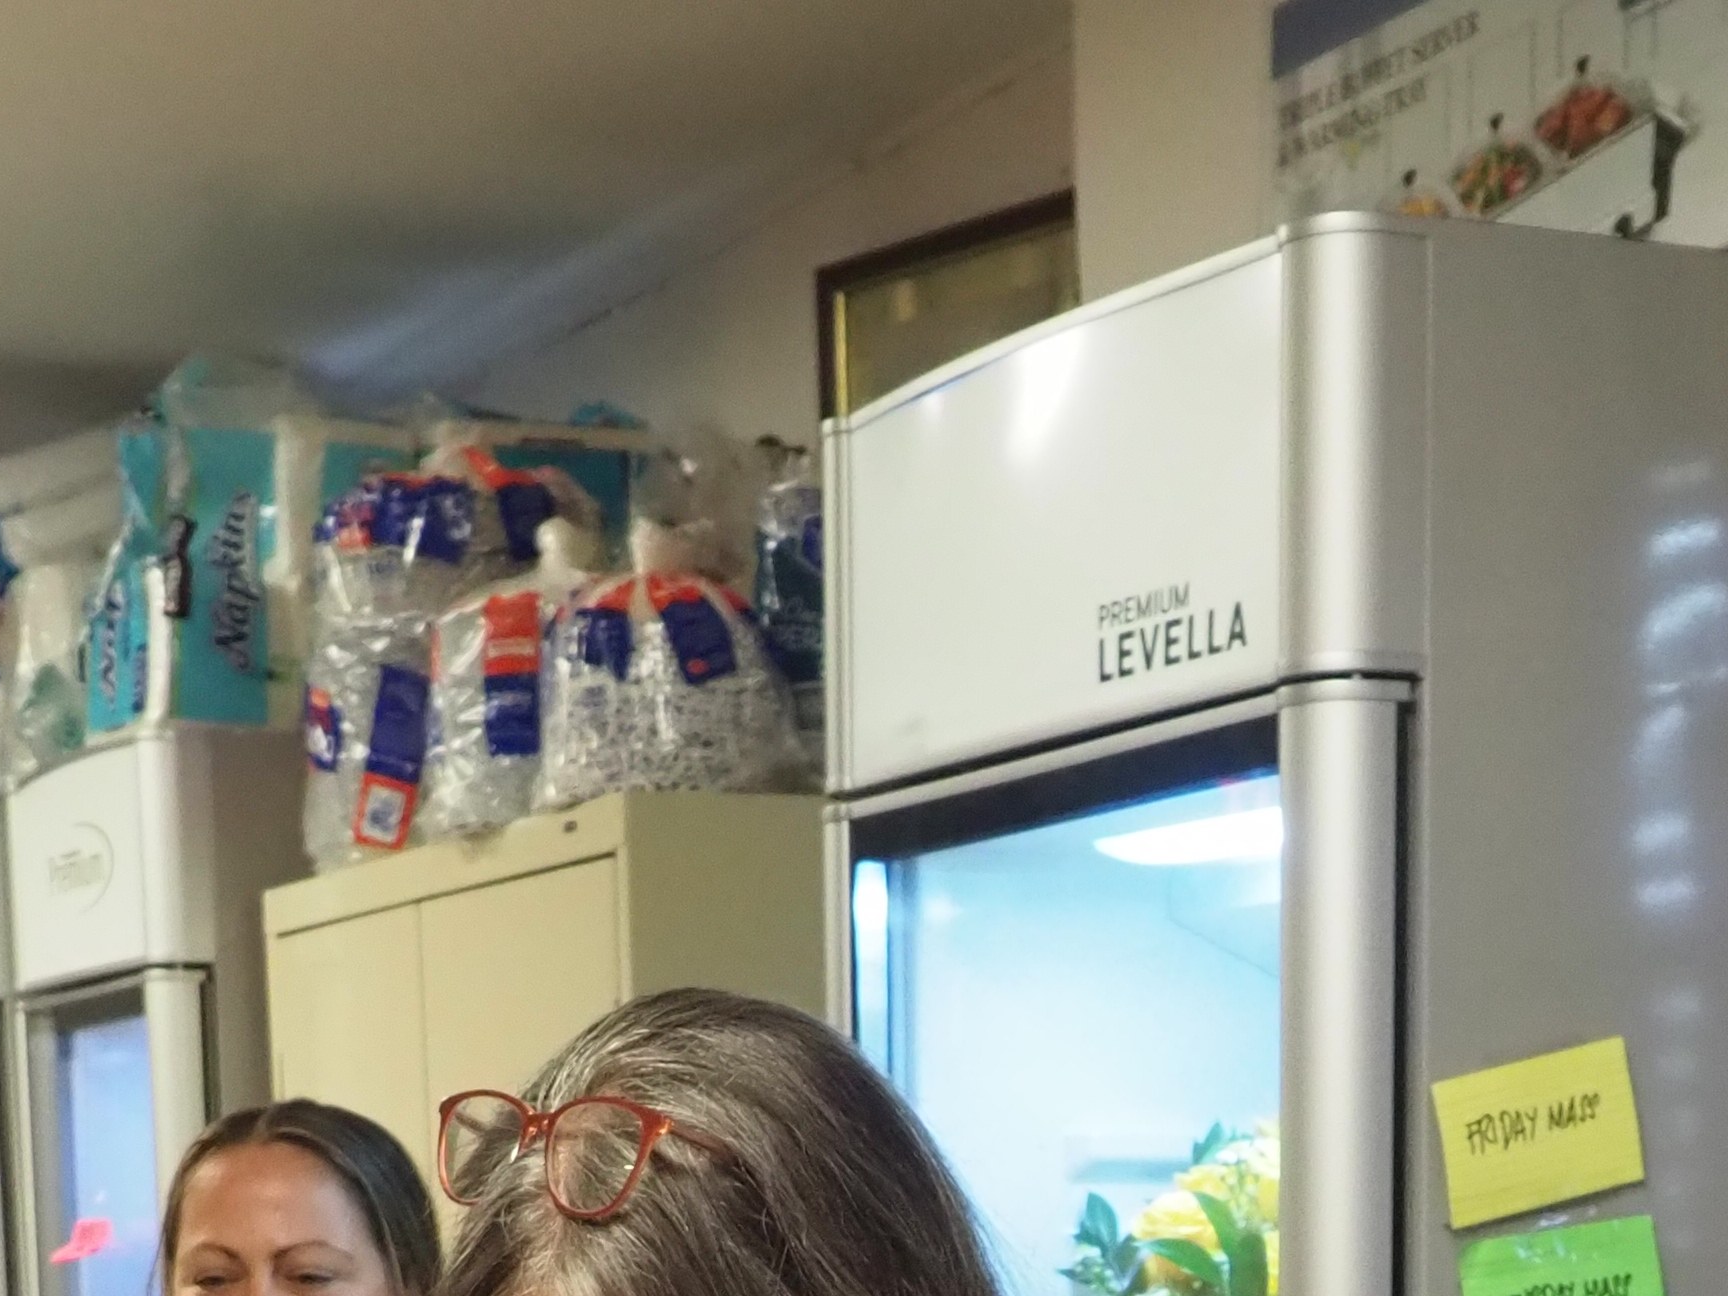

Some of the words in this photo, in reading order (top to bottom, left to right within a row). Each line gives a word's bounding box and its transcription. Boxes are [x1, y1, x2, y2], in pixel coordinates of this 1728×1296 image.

[1098, 582, 1189, 629] PREMIUM
[1098, 600, 1247, 683] LEVELLA
[1465, 1106, 1539, 1155] FRIDAY
[1548, 1093, 1600, 1130] MASS
